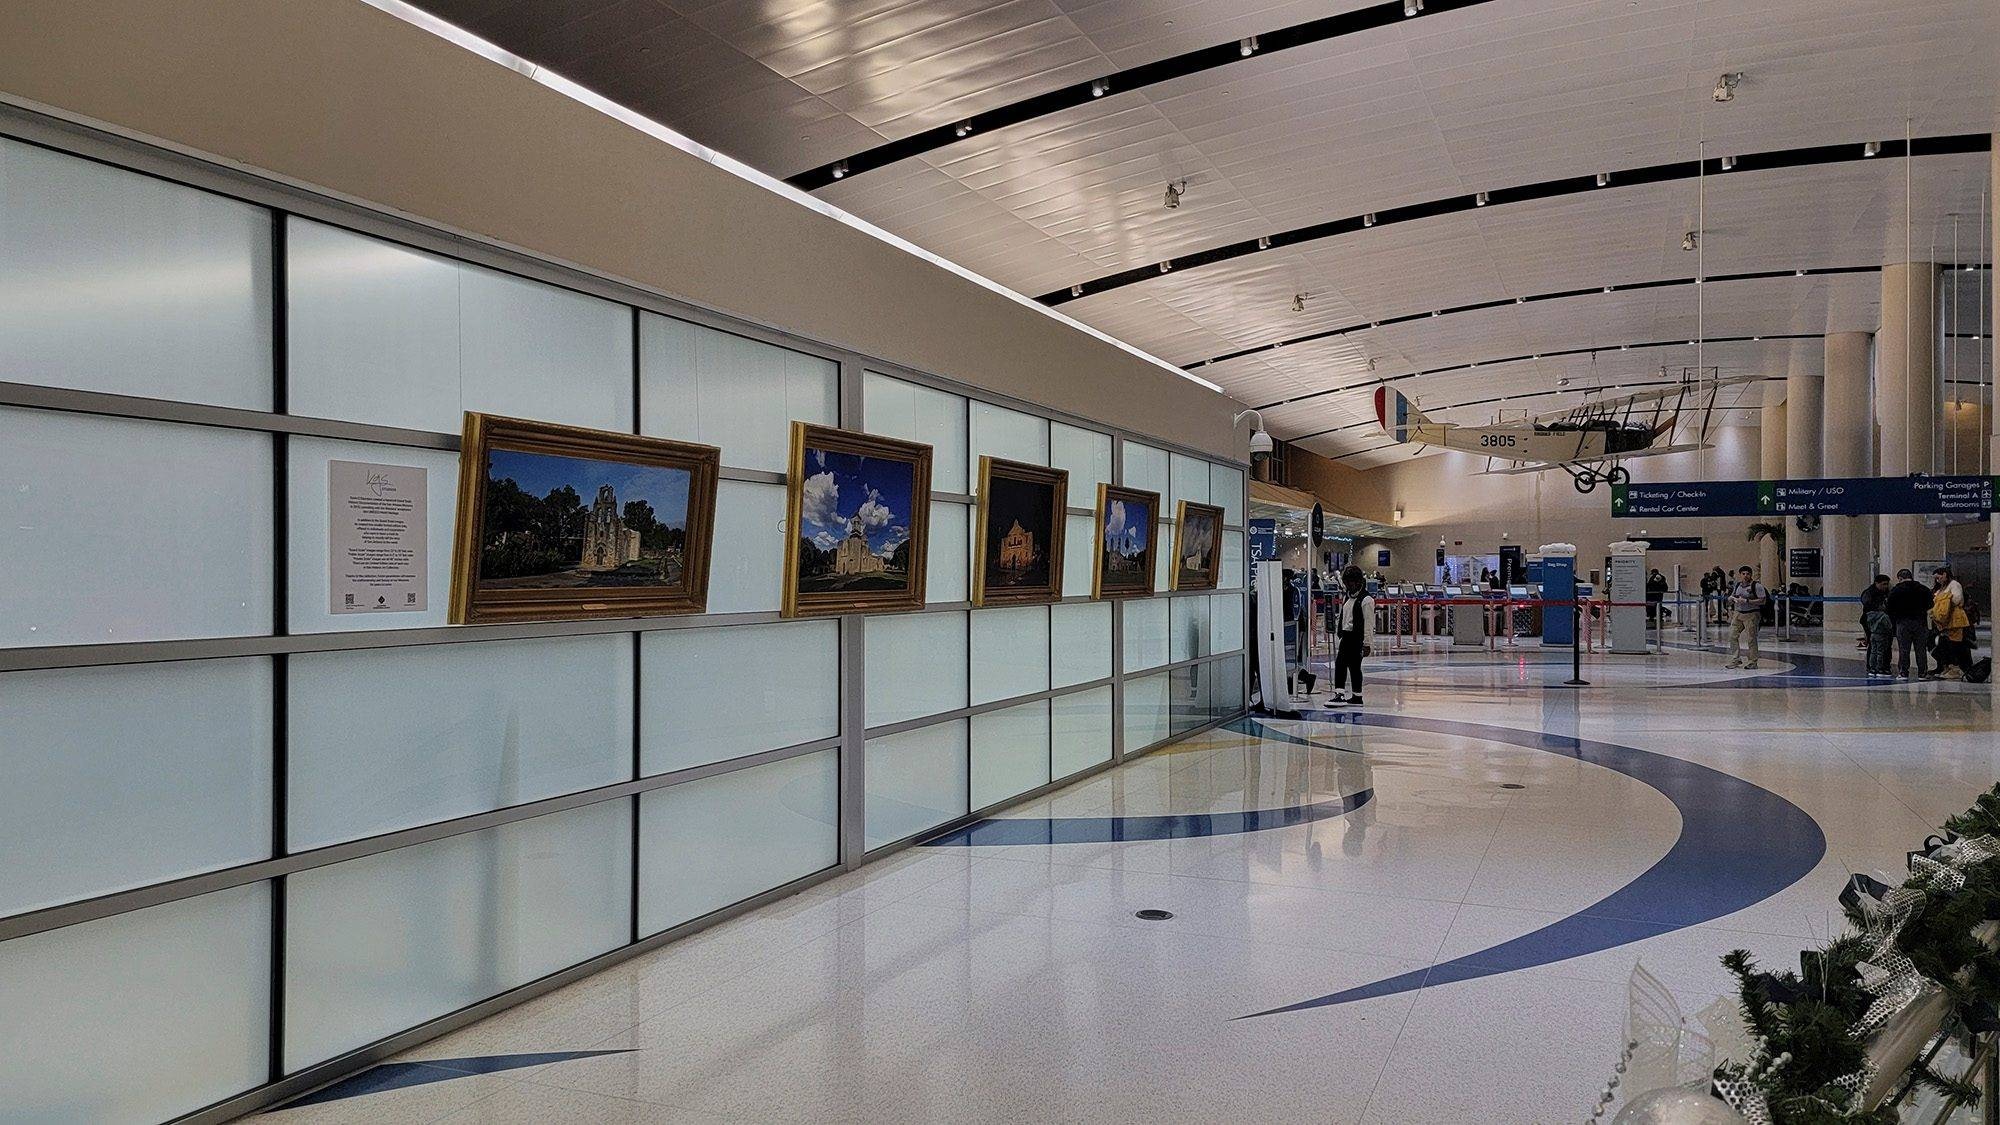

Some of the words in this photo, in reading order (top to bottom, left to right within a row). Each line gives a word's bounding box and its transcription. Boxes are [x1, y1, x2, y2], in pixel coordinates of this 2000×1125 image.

[1480, 435, 1516, 447] 3805
[1914, 482, 1944, 490] Parking
[1945, 481, 1980, 490] Garages
[1640, 491, 1669, 500] Ticketing
[1677, 490, 1707, 498] Check-In
[1788, 487, 1817, 496] Military
[1825, 487, 1845, 495] USO
[1817, 502, 1839, 510] Greet
[1250, 542, 1262, 565] TSA
